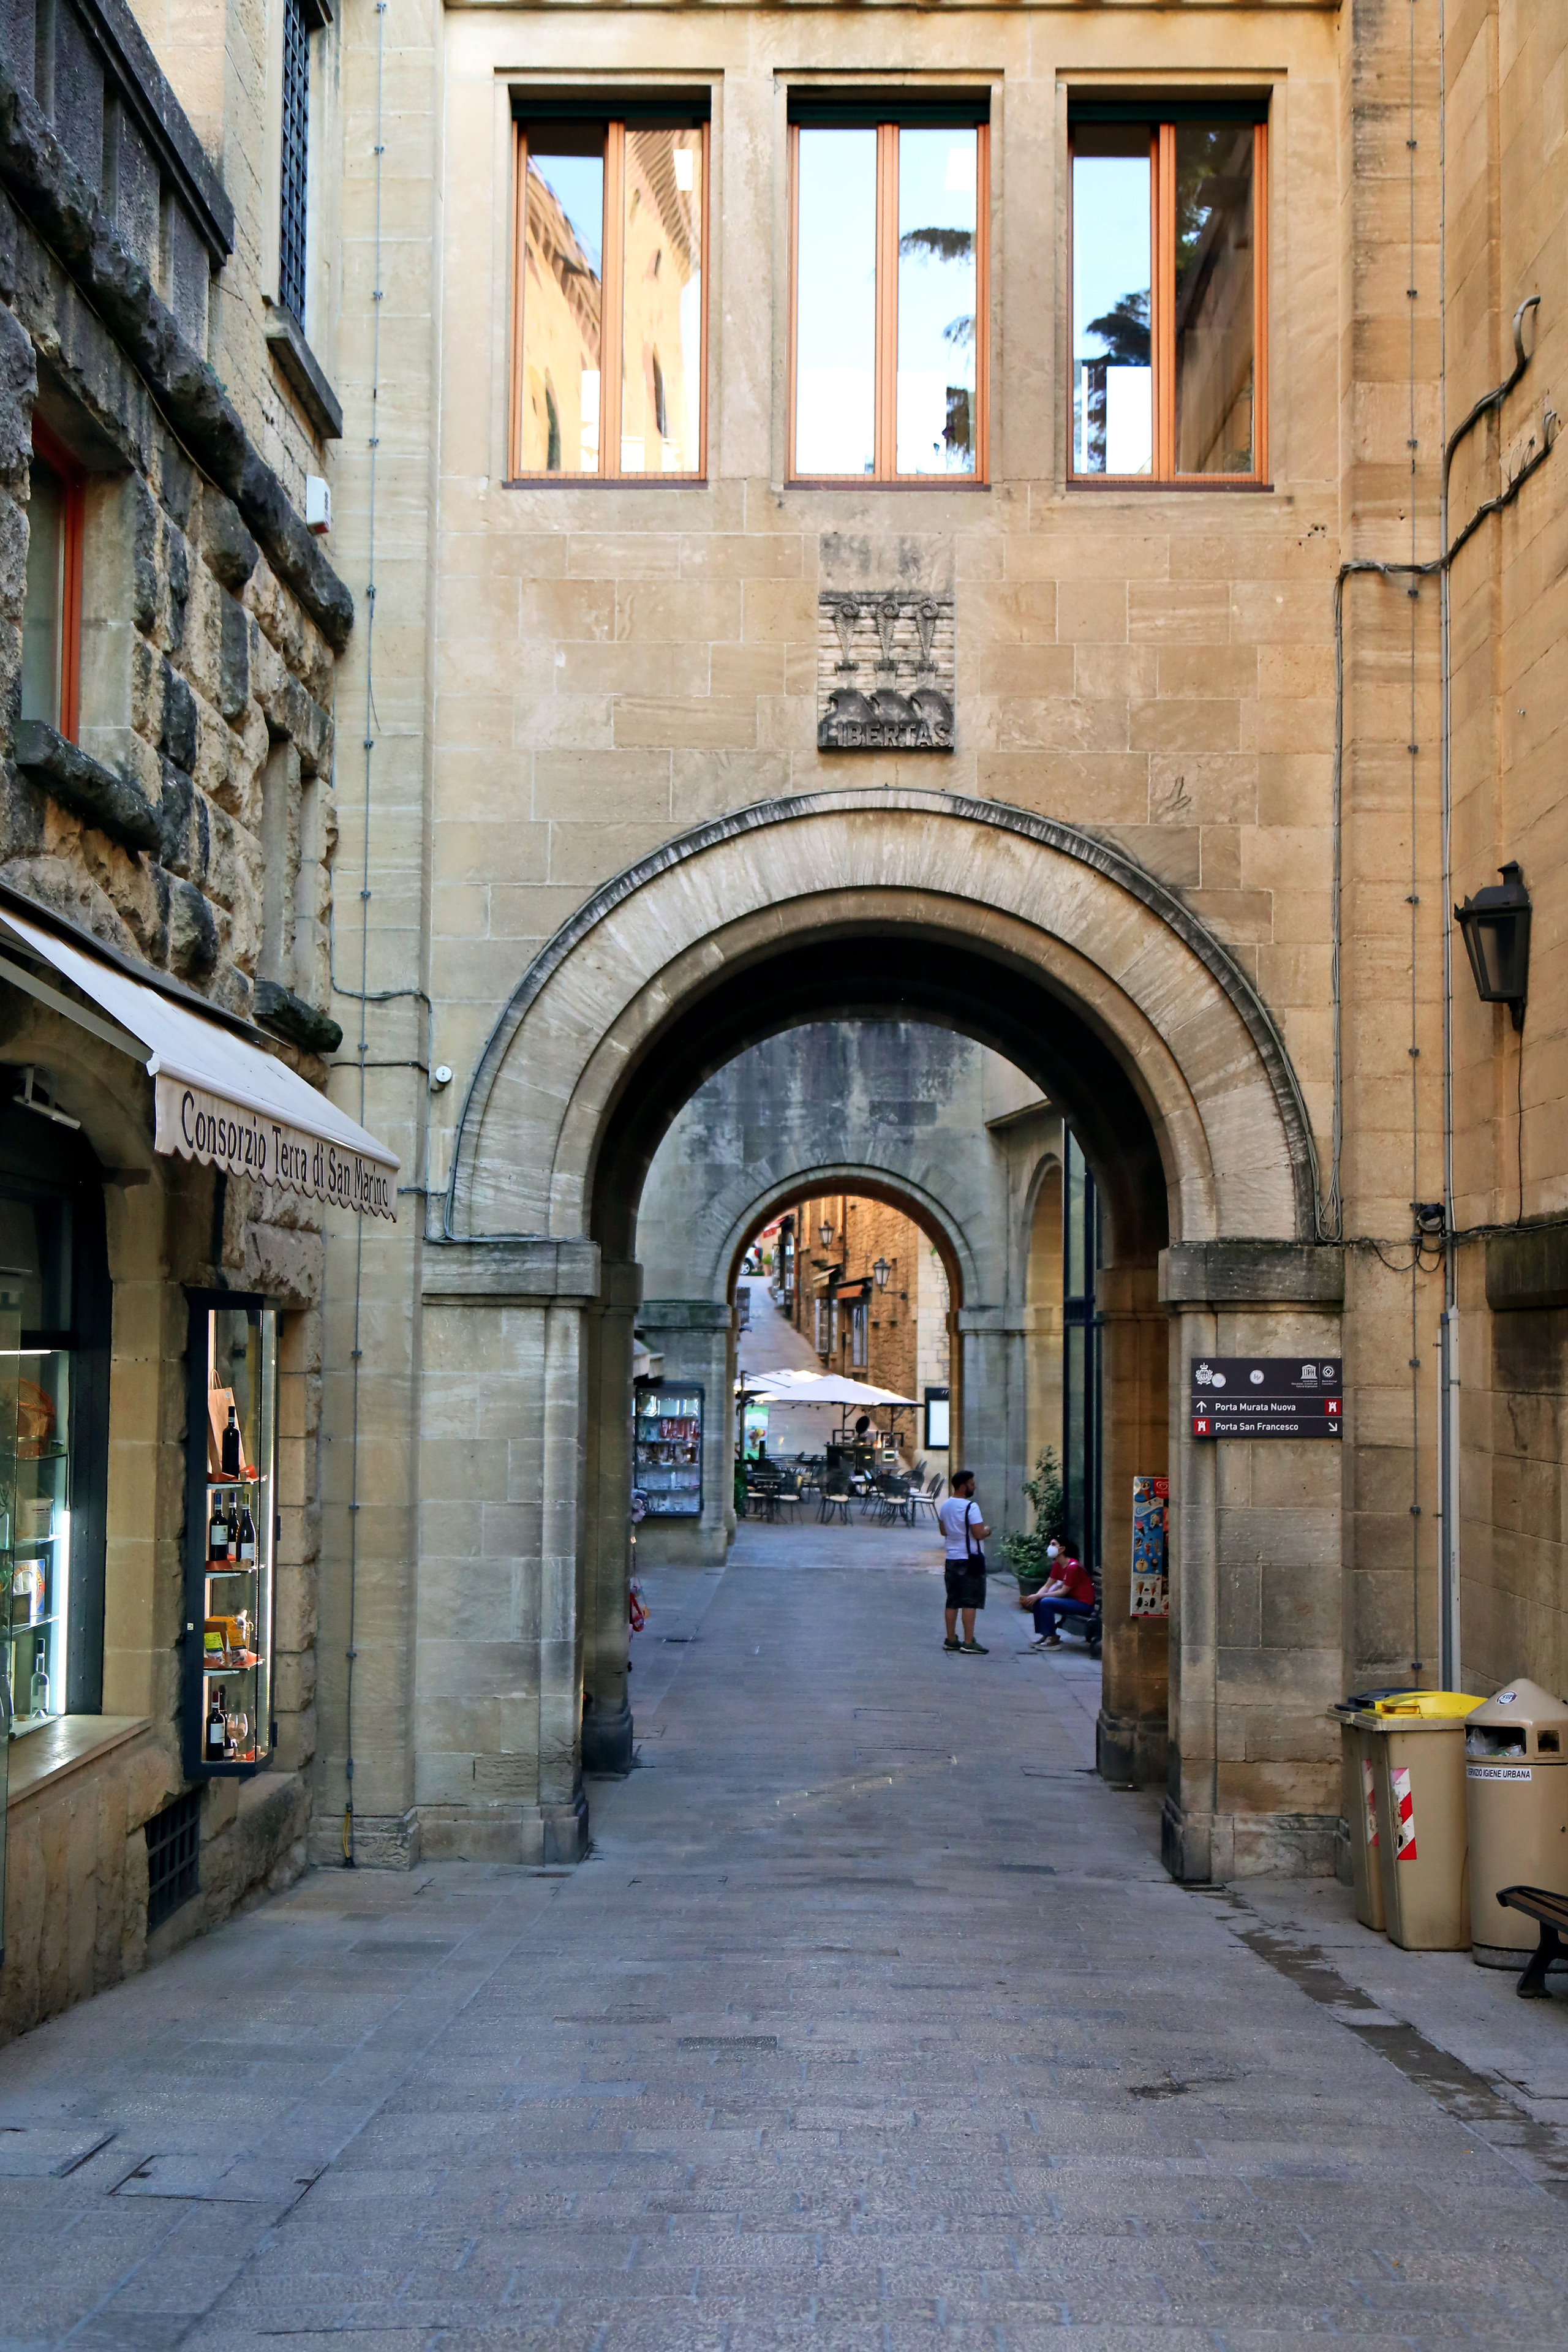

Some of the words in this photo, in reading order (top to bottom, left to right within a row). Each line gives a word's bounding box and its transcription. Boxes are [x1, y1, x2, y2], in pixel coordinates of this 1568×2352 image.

[820, 723, 951, 747] LIBERTAS
[181, 1090, 267, 1170] Consorzio
[272, 1125, 307, 1183] Terra
[313, 1142, 325, 1188] di
[328, 1147, 351, 1197] San
[354, 1157, 389, 1208] Marino
[1483, 1769, 1502, 1777] IGIENE
